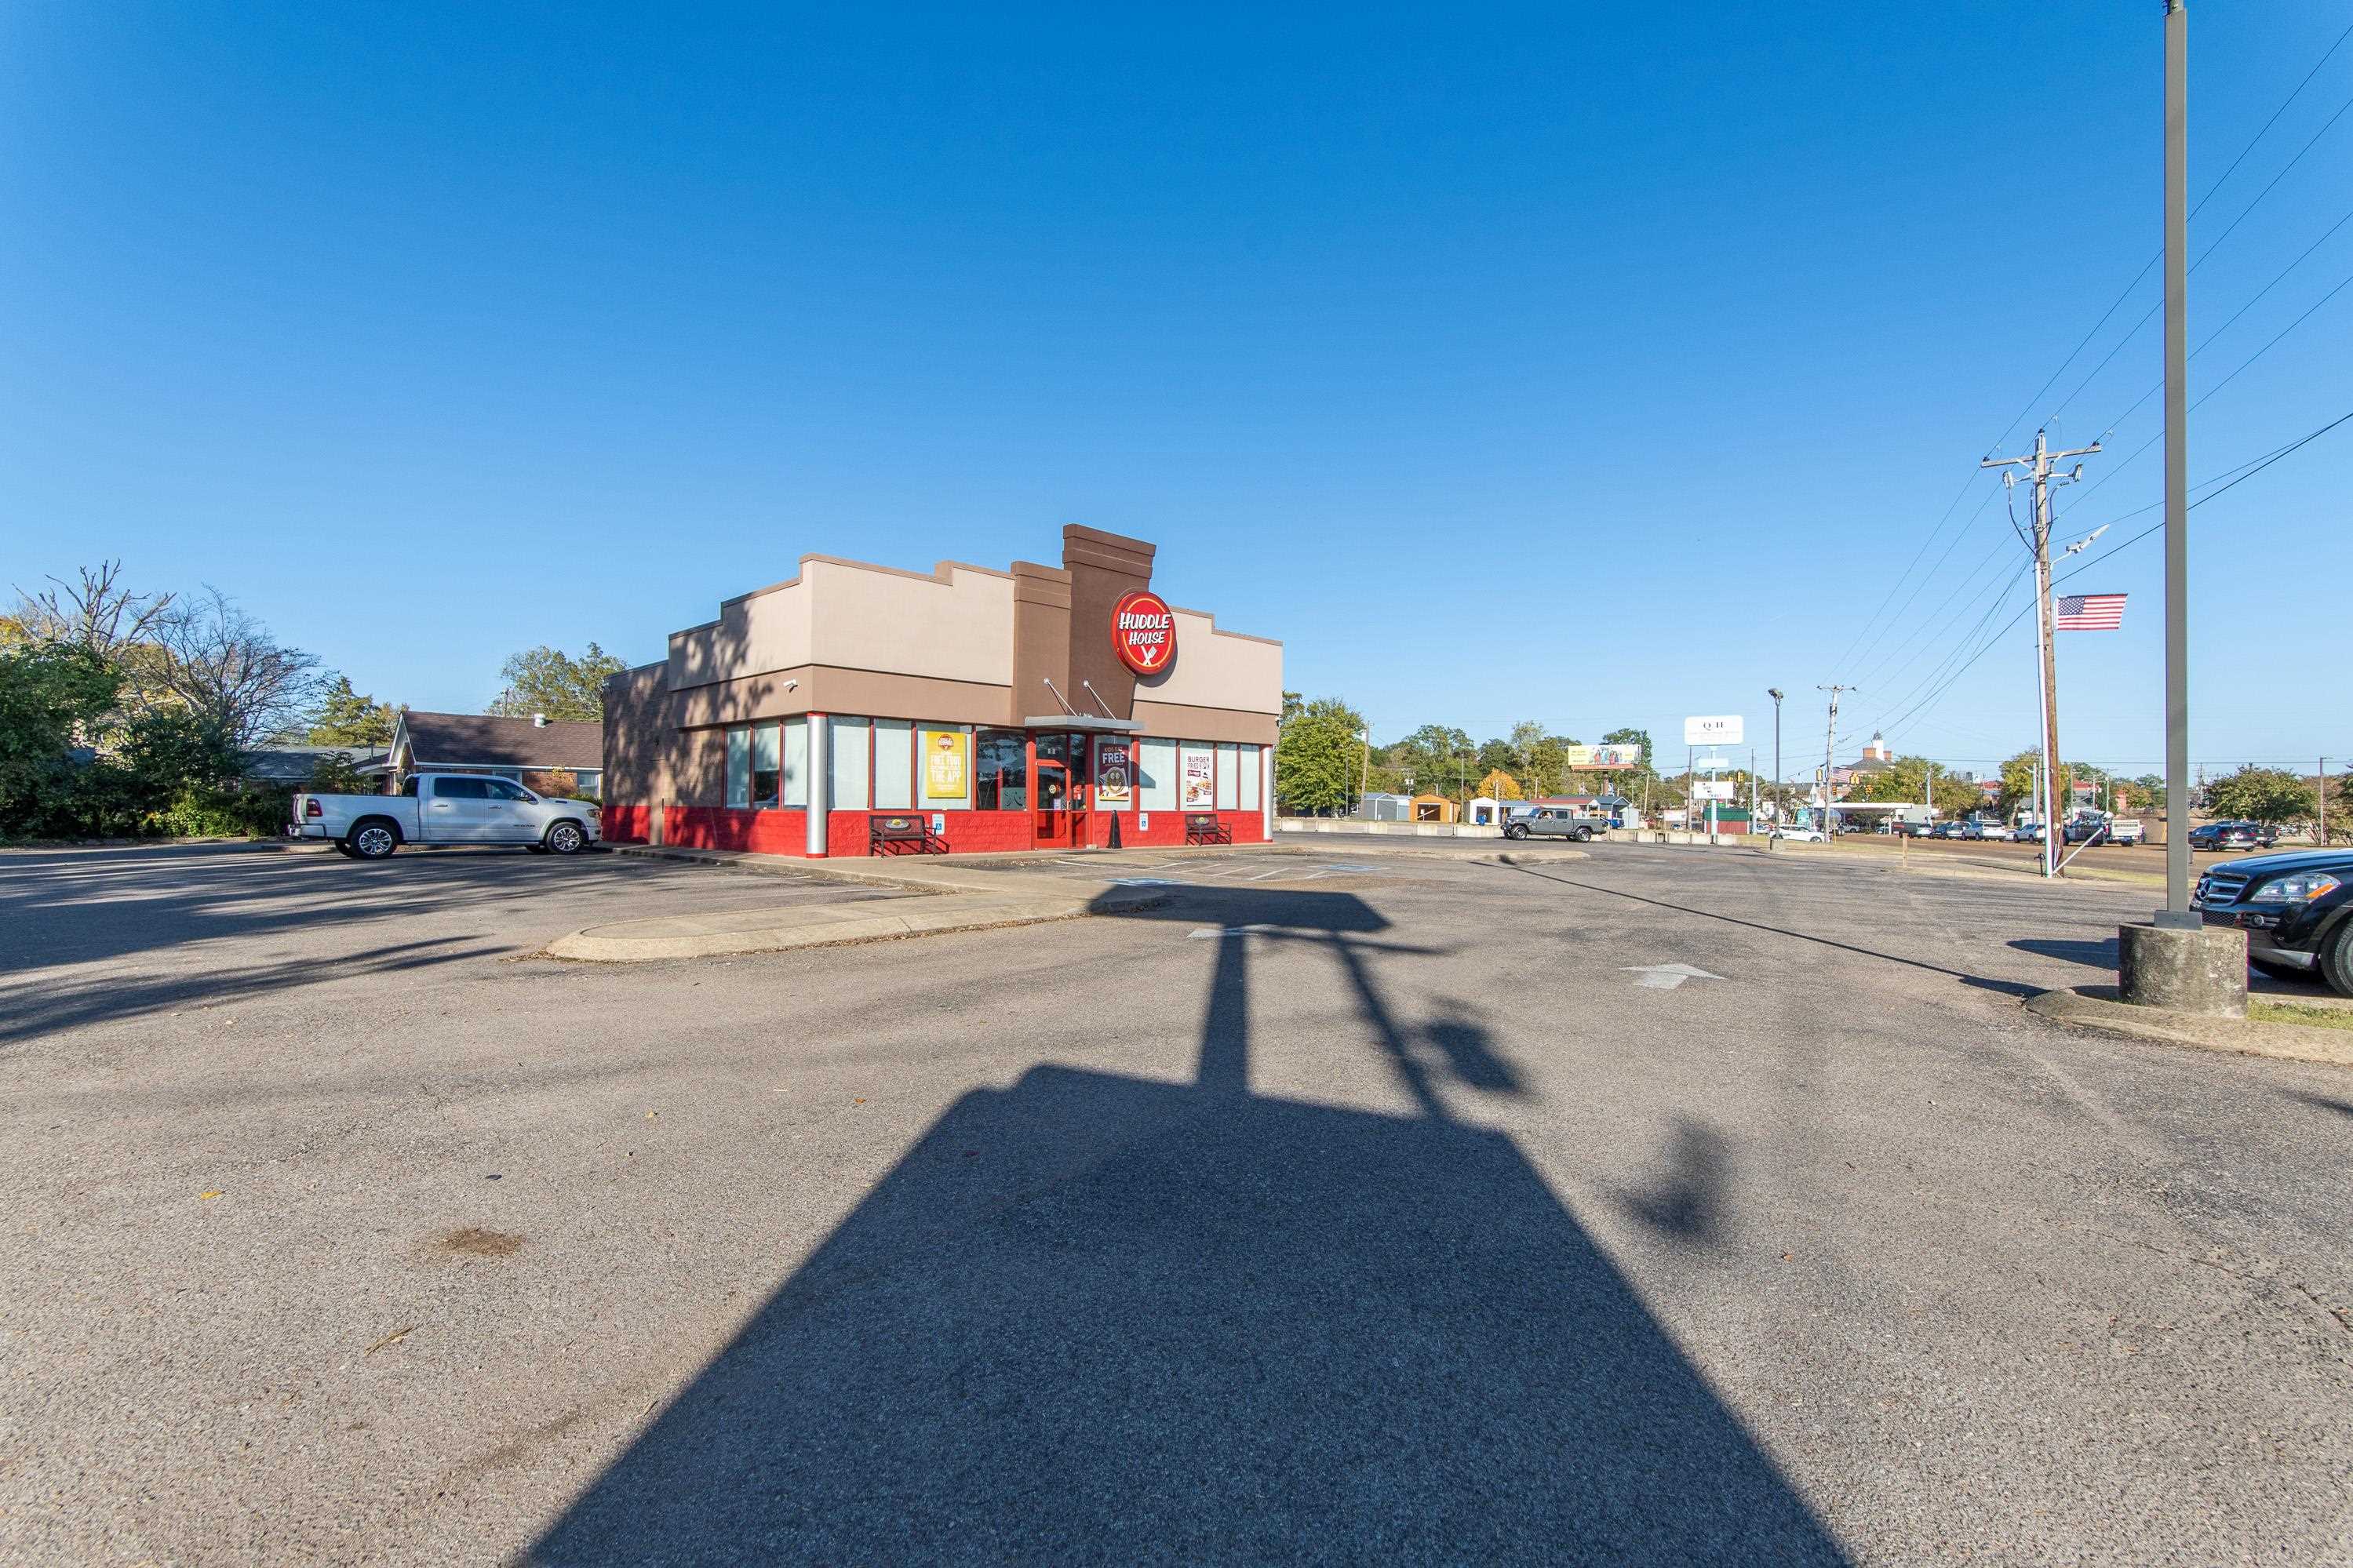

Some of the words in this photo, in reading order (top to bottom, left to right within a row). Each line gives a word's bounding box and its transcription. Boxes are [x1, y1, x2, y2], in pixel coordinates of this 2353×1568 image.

[1119, 612, 1171, 630] HUDDLE
[1128, 631, 1166, 646] HOUSE
[930, 755, 945, 766] FREE
[1102, 752, 1125, 764] FREE
[930, 769, 945, 783] THE
[946, 769, 961, 783] APP
